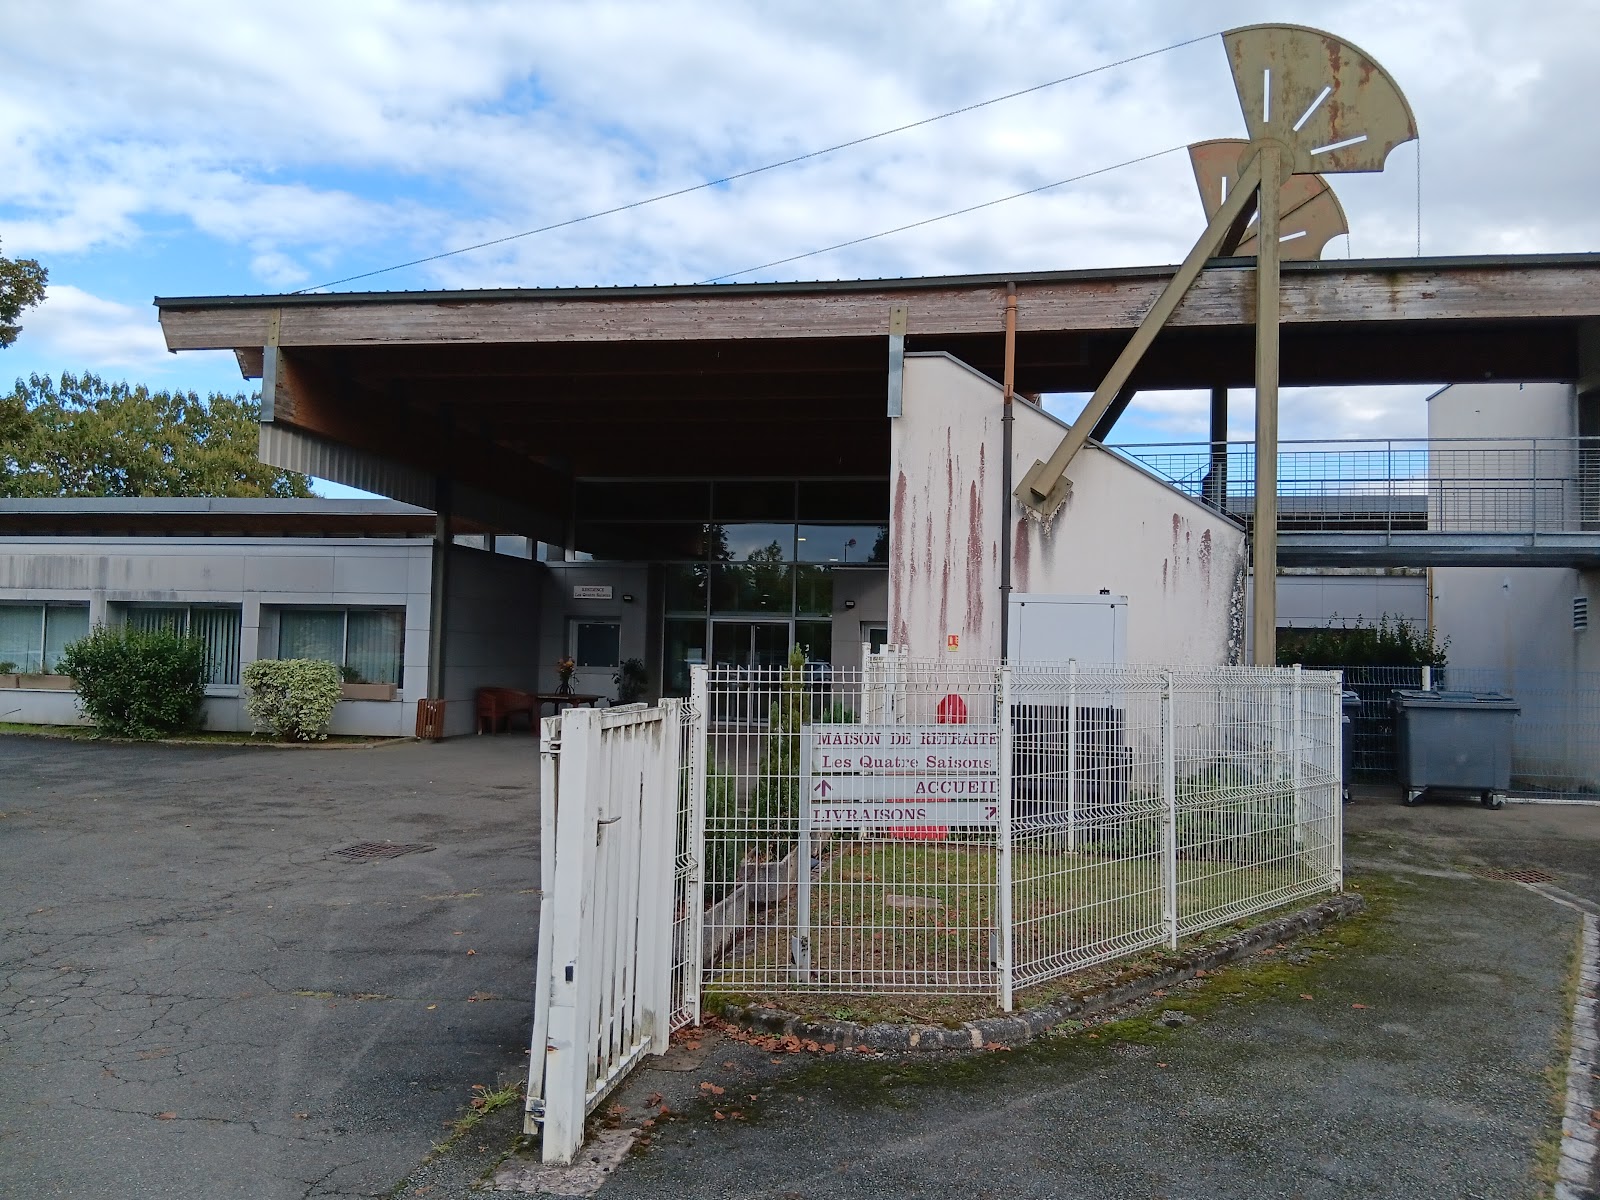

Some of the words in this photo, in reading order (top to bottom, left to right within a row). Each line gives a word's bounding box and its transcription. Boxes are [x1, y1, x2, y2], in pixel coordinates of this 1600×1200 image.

[817, 732, 881, 745] MAISON
[890, 732, 911, 745] DE
[920, 732, 997, 745] RETRAITE
[822, 755, 851, 769] Les
[859, 755, 918, 769] Quatre
[926, 755, 992, 769] Saisons
[915, 781, 997, 794] ACCUEIL
[813, 808, 926, 823] LIVRAISONS
